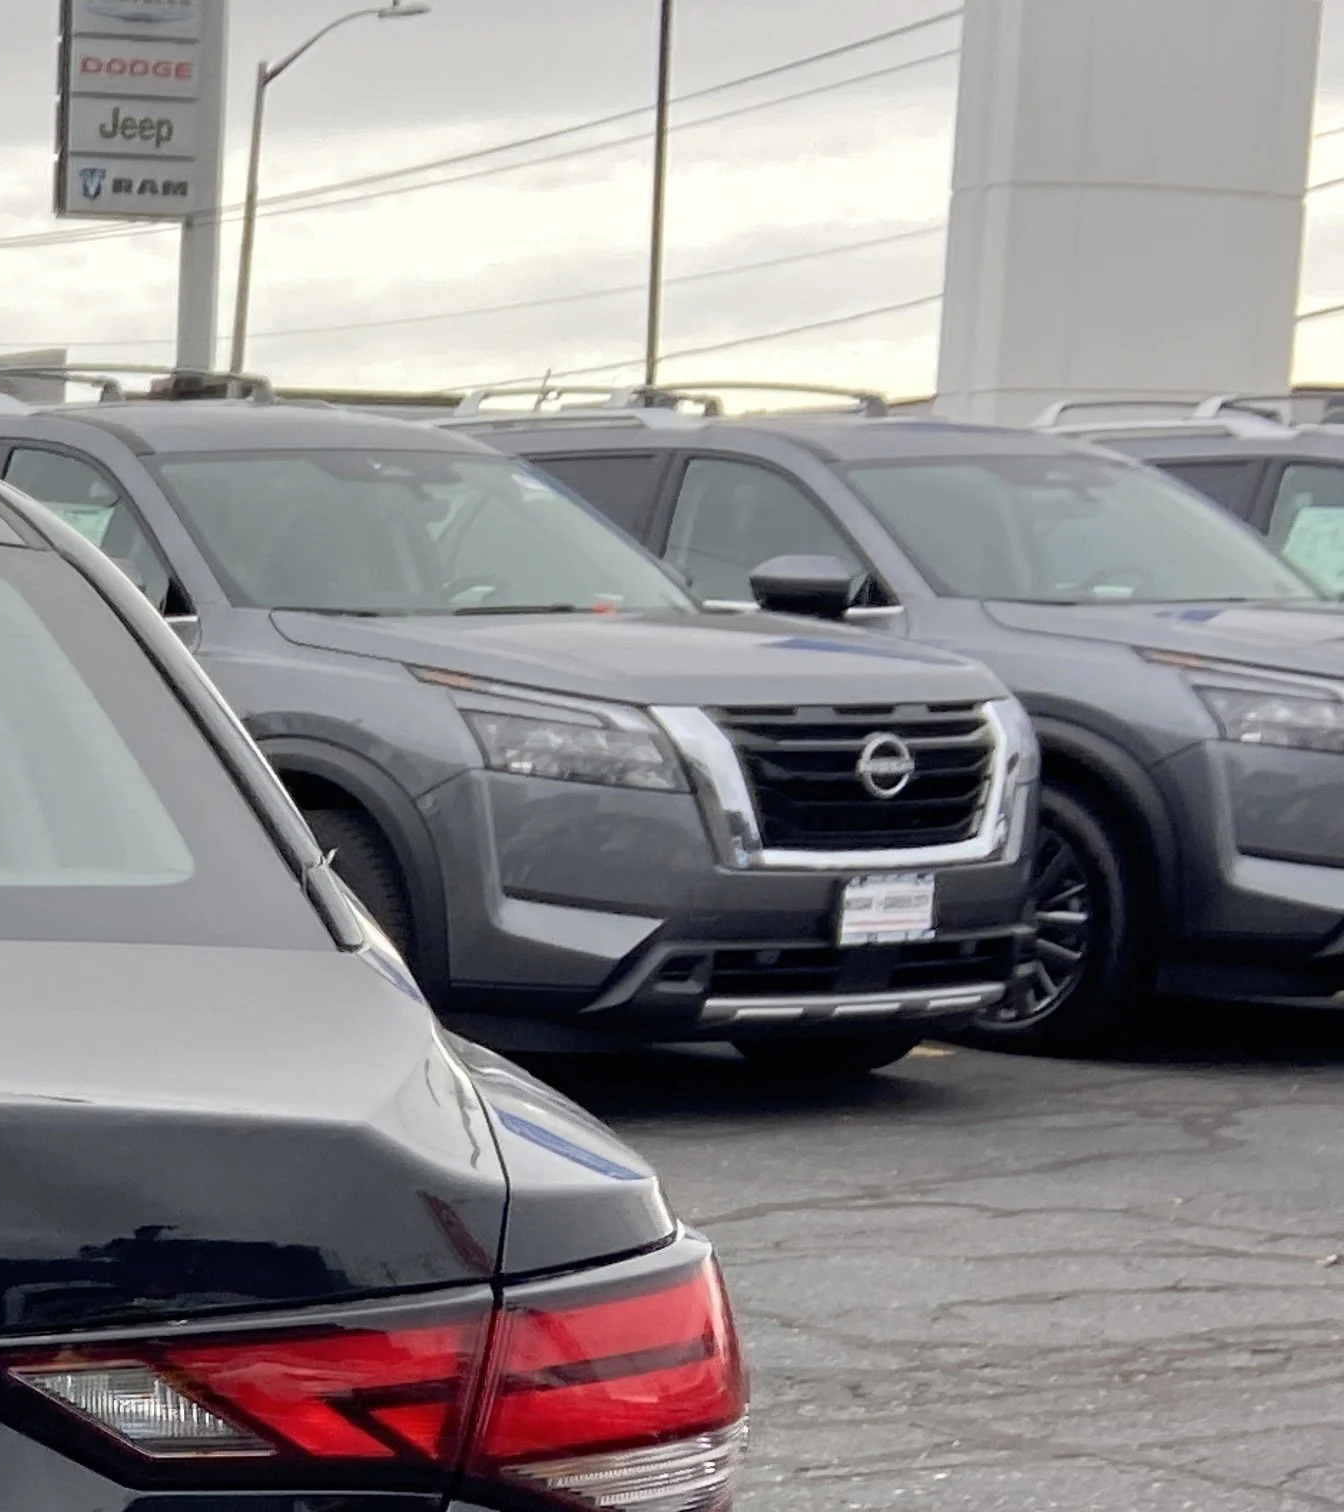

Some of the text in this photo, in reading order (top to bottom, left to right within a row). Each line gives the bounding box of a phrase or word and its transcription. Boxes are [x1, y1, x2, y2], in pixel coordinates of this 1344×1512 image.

[80, 57, 194, 80] DODGE
[99, 105, 174, 148] Jeep
[112, 177, 188, 197] RAM
